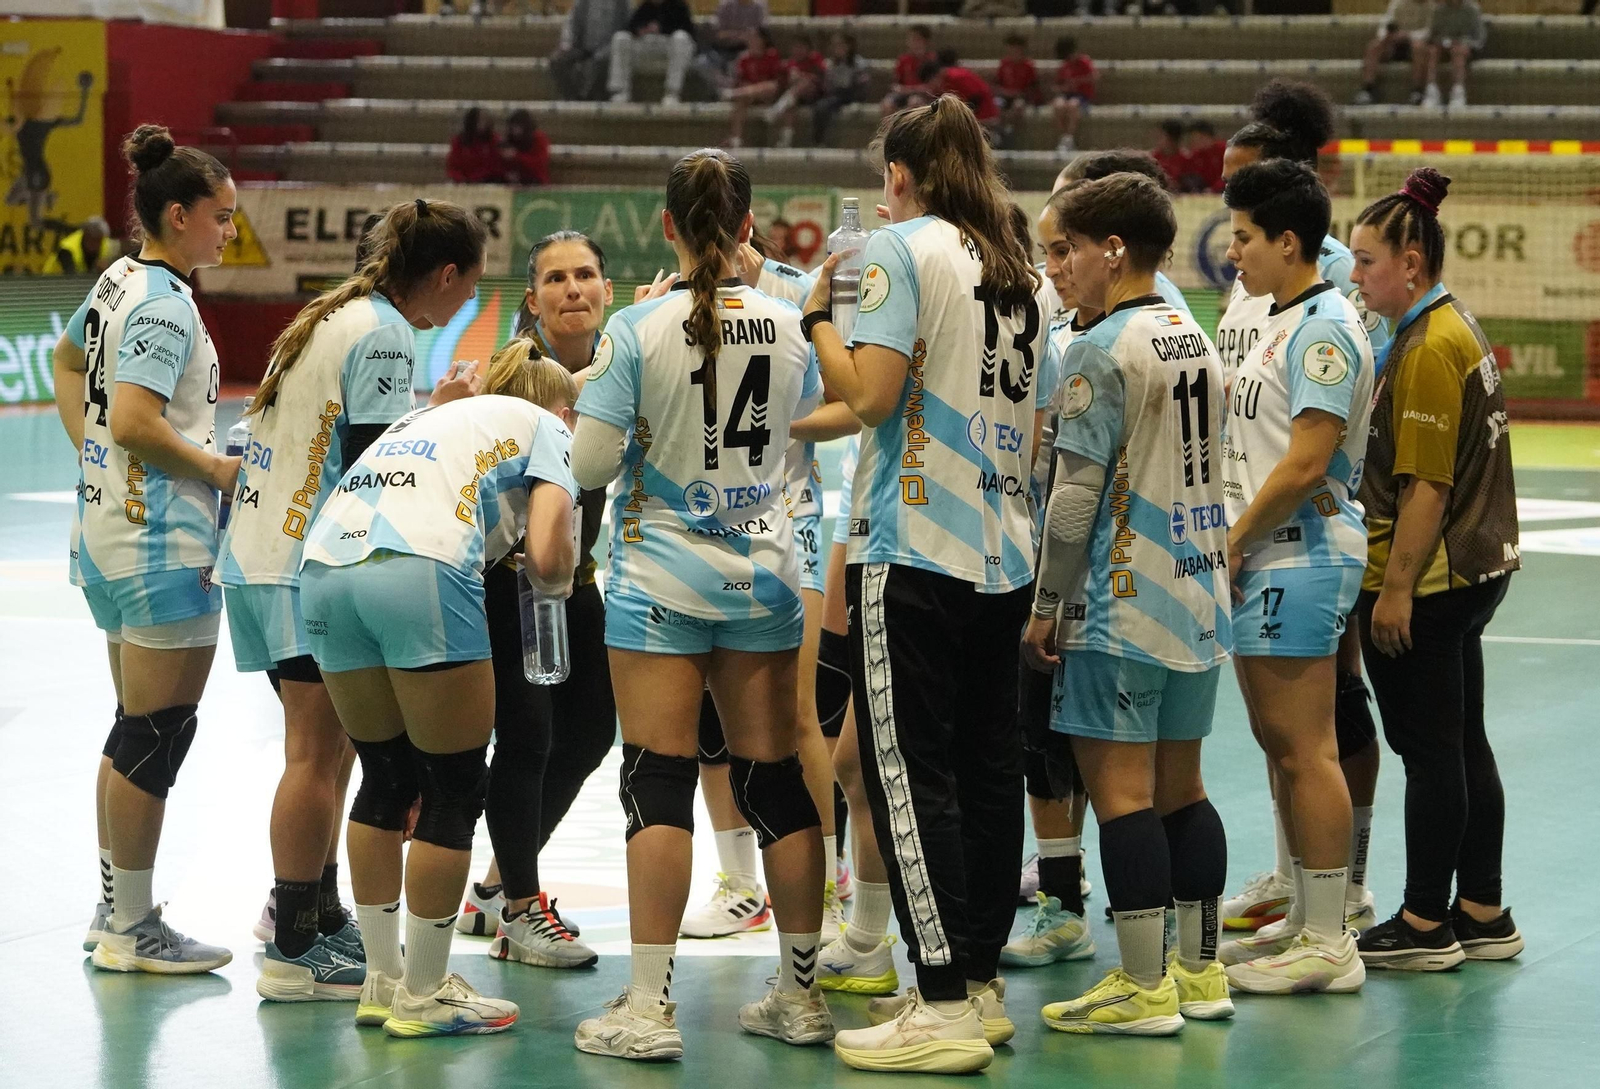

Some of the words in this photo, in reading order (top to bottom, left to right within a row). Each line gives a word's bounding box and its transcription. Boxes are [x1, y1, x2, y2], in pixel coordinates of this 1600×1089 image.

[682, 317, 777, 346] SRANO
[0, 312, 63, 400] erd
[154, 345, 180, 363] DEPORTE
[1152, 333, 1211, 362] CACHEDA
[151, 352, 176, 369] GALEGO
[690, 354, 771, 470] 14
[1173, 368, 1210, 487] 11
[293, 400, 341, 509] PipeWorks
[375, 440, 437, 461] TESOL
[340, 529, 367, 541] ZICO
[722, 582, 751, 591] ZICO
[1261, 587, 1285, 617] 17
[1259, 631, 1282, 640] ZICO
[1312, 871, 1345, 879] ZICO
[1121, 911, 1160, 920] ZICO
